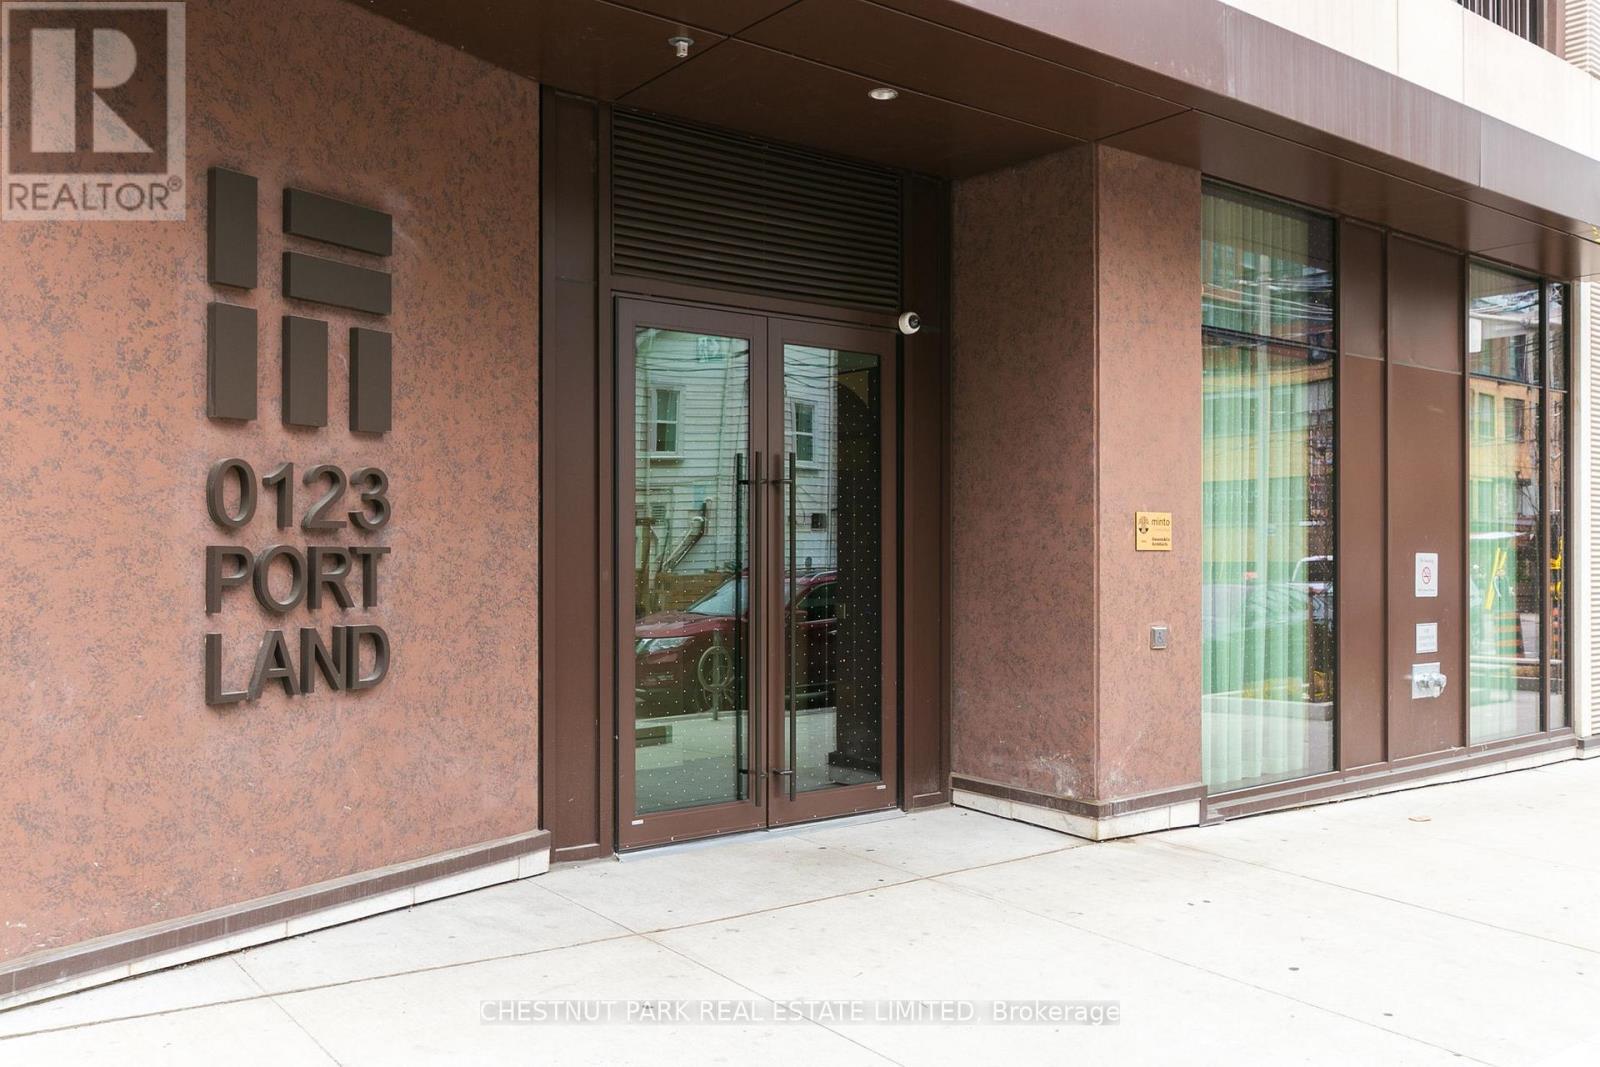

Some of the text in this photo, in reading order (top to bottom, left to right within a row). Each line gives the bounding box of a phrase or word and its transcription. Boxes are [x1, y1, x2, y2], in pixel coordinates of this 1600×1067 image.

[206, 458, 392, 530] 0123
[1151, 518, 1171, 527] minto
[205, 544, 392, 614] PORT
[205, 625, 391, 706] LAND
